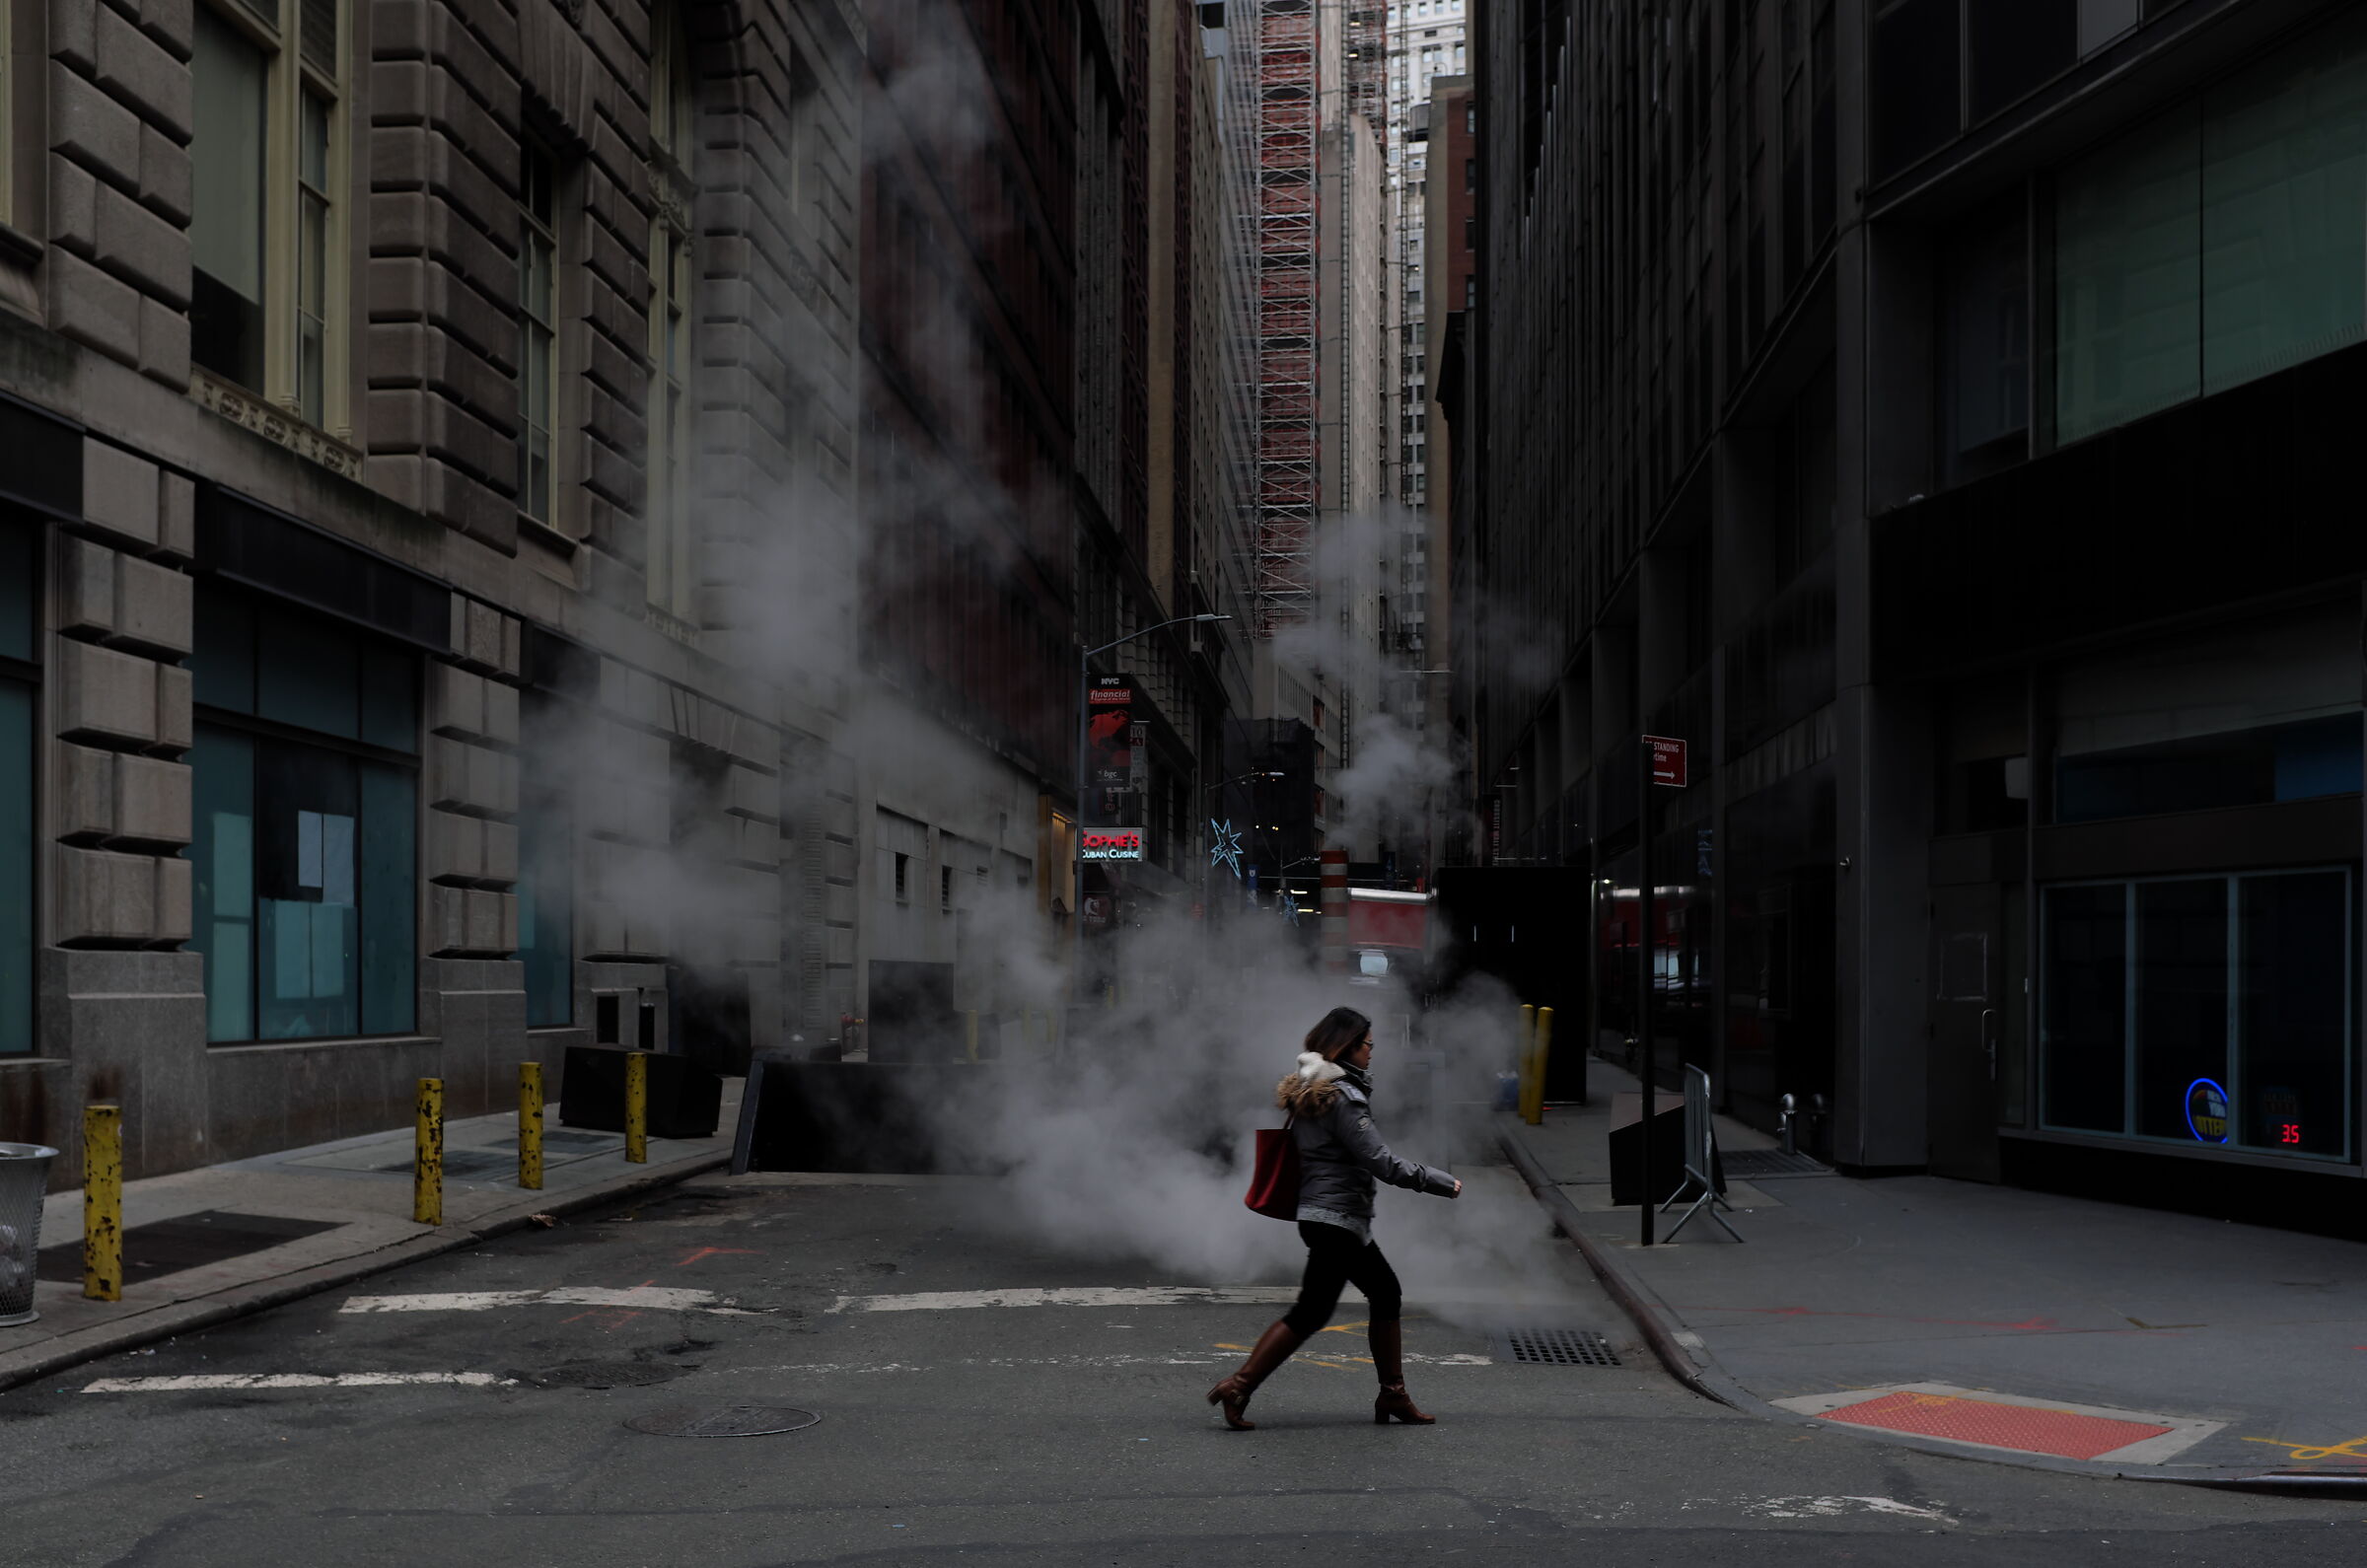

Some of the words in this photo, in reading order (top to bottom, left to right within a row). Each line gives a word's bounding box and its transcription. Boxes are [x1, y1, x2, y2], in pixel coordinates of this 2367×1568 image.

[1090, 689, 1130, 700] financial
[1653, 742, 1680, 753] STANDING
[1109, 849, 1140, 859] CUISINE
[2281, 1123, 2301, 1144] 35
